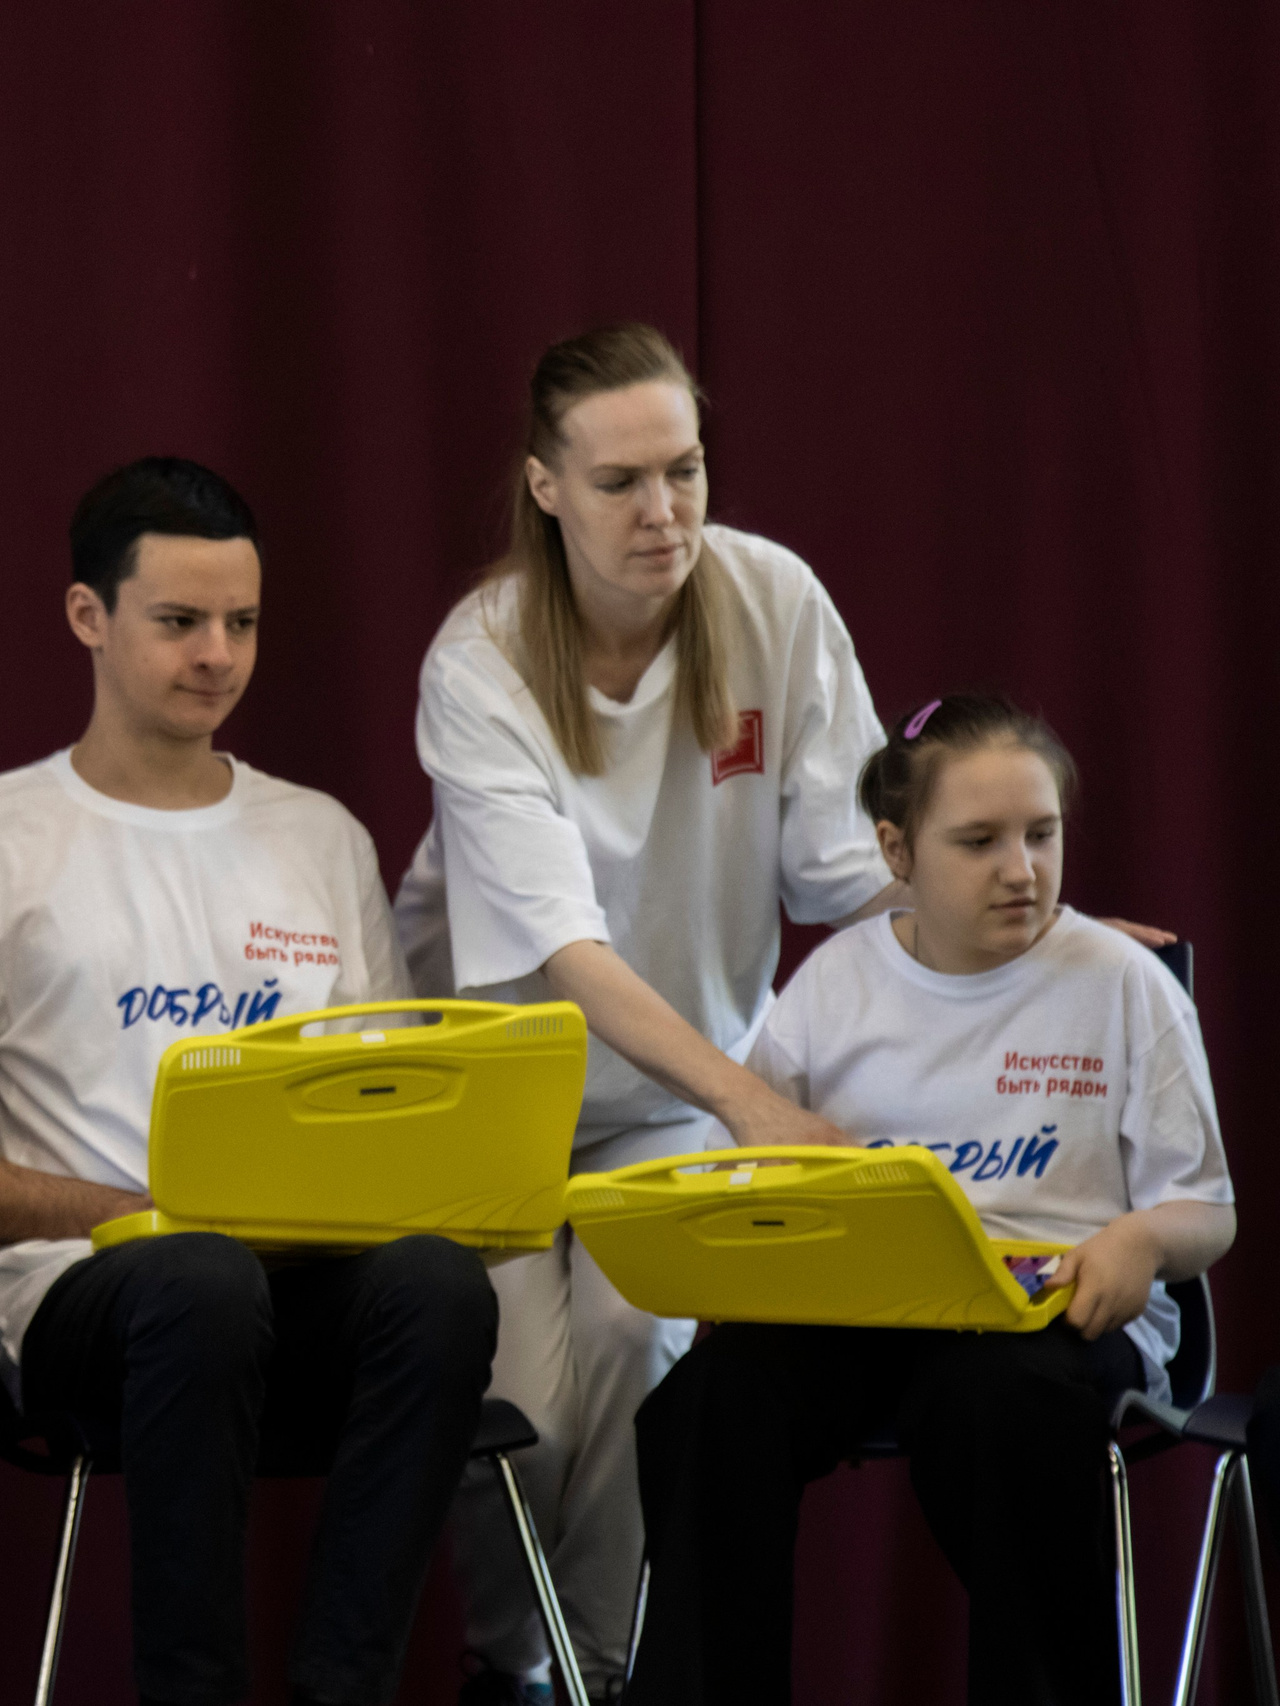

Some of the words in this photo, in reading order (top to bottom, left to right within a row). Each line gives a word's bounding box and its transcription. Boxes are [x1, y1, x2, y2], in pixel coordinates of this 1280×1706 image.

[249, 921, 339, 949] Искусство
[244, 943, 288, 963] быть
[293, 950, 339, 967] рядо
[117, 978, 283, 1030] ДОБРЫЙ
[1004, 1051, 1104, 1075] Искусство
[996, 1075, 1041, 1095] быть
[1045, 1077, 1108, 1098] рядом
[866, 1124, 1060, 1182] РЫЙ
